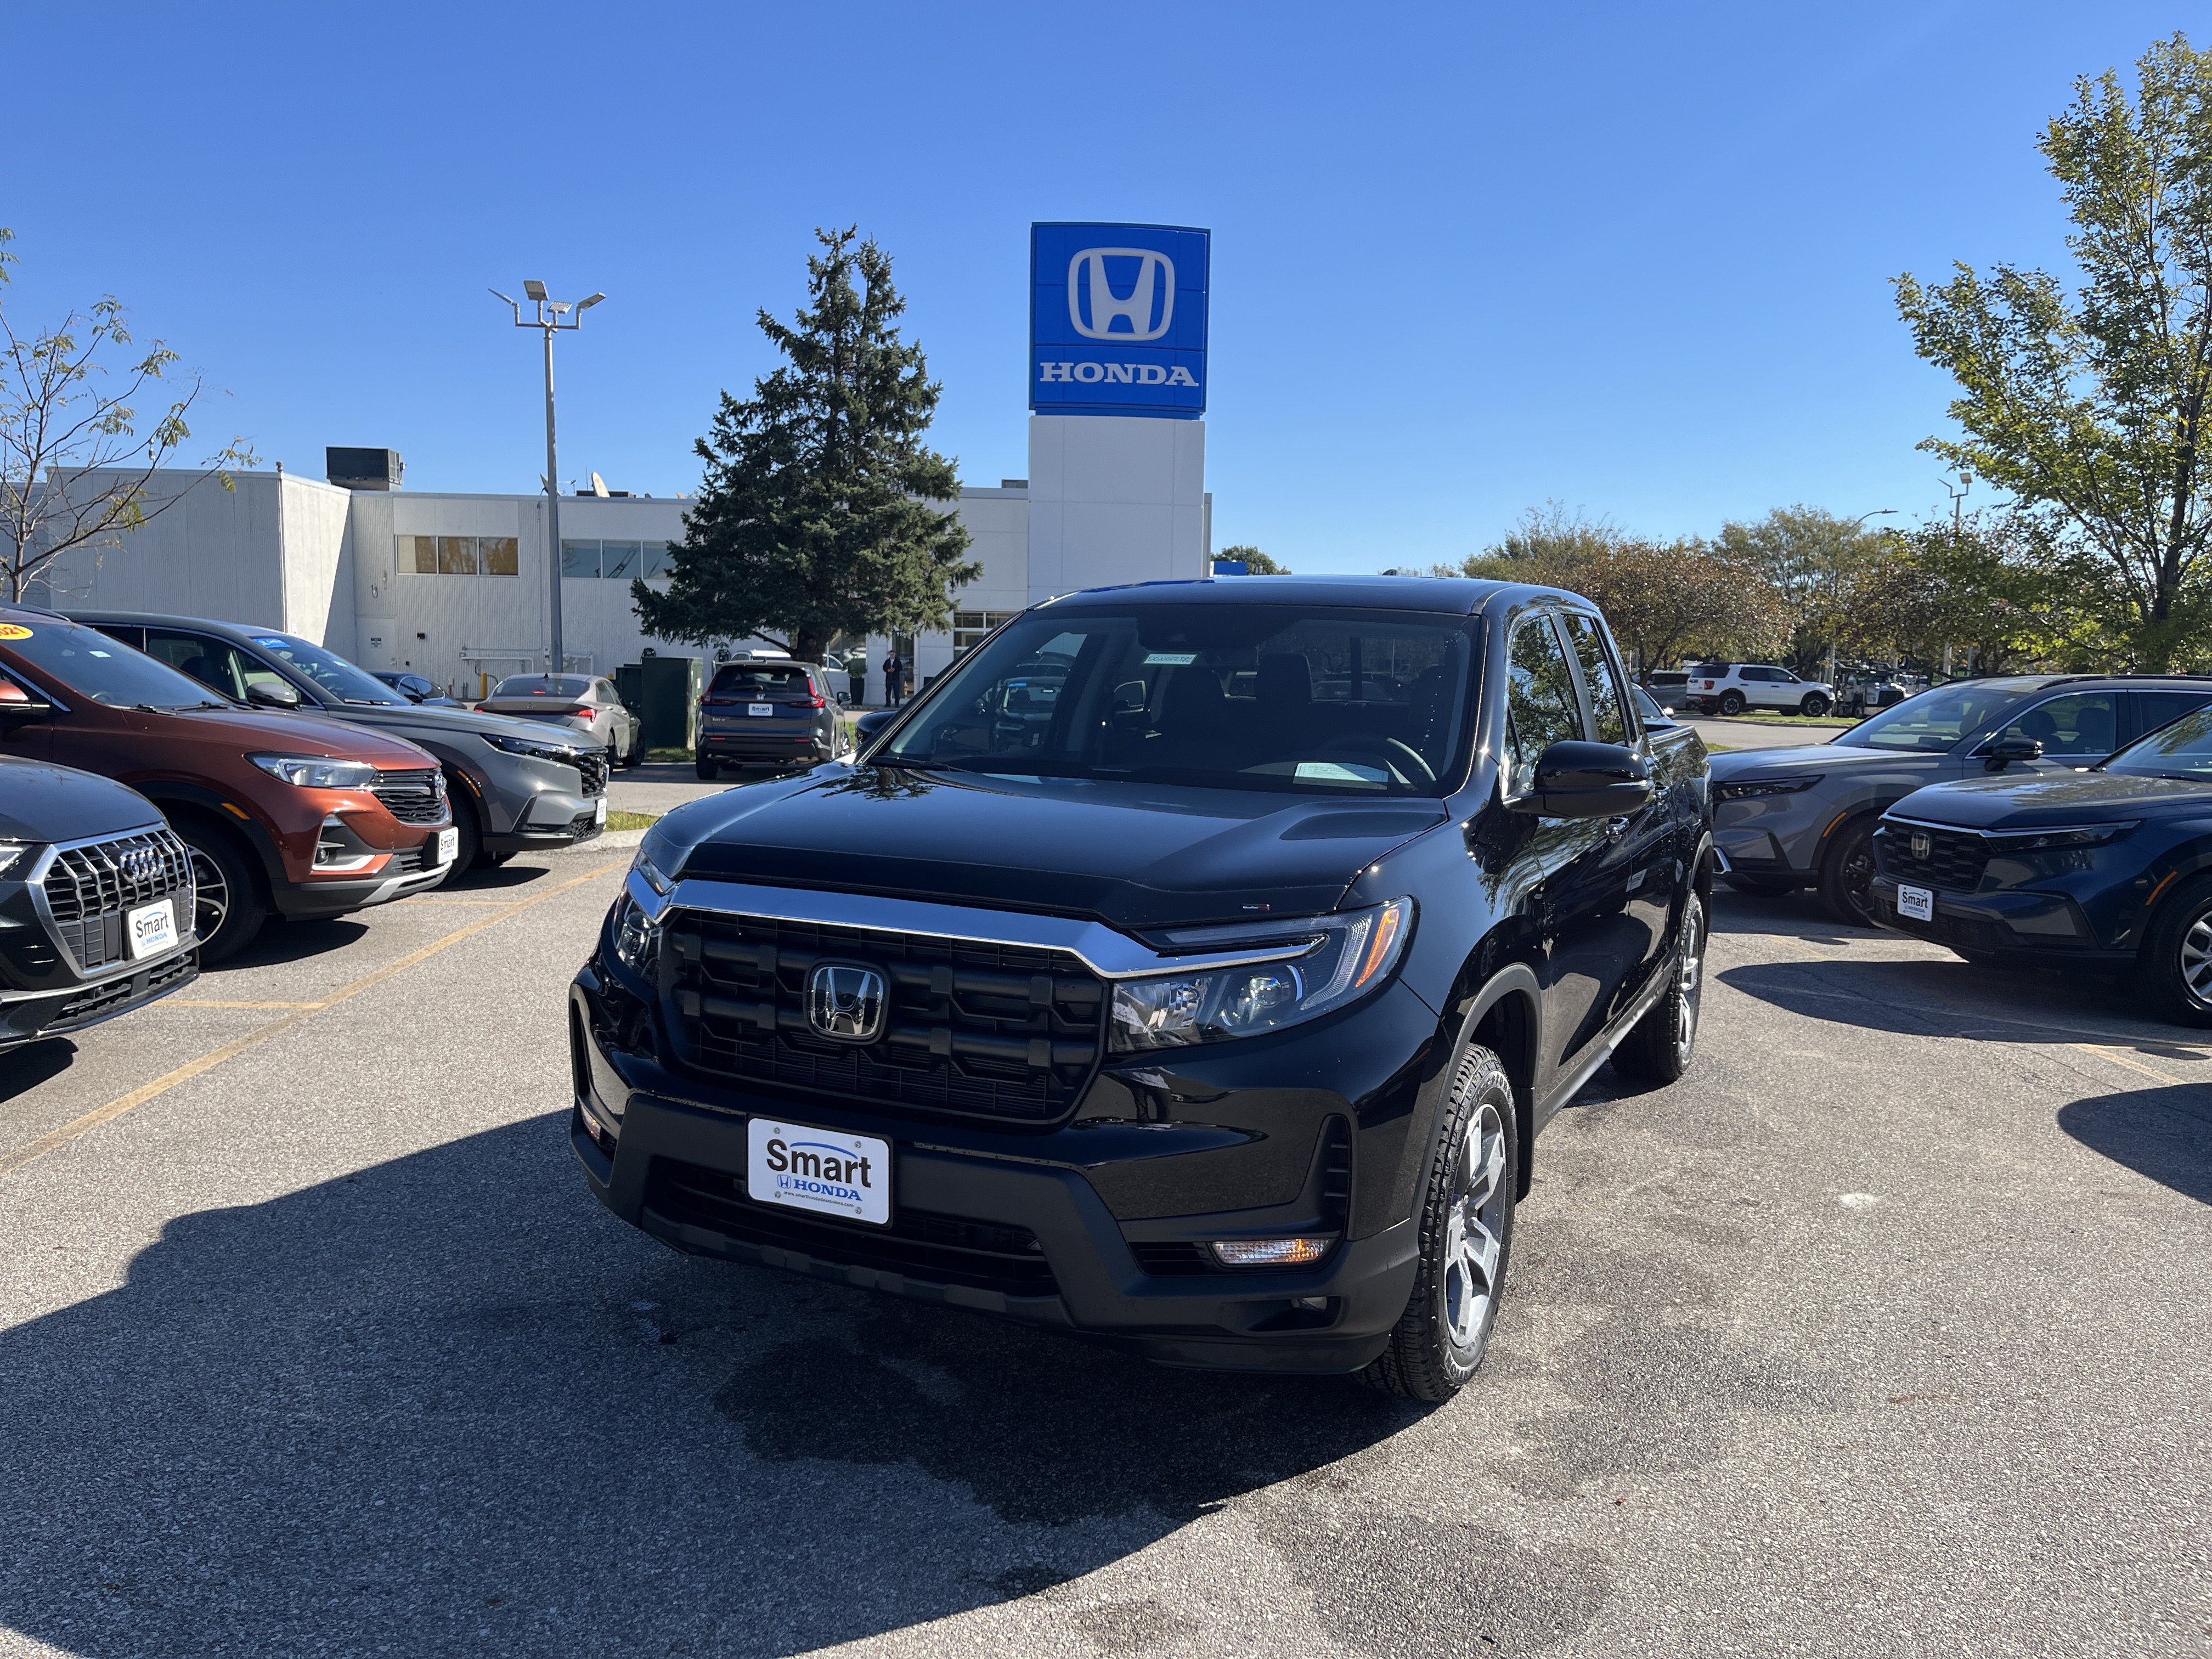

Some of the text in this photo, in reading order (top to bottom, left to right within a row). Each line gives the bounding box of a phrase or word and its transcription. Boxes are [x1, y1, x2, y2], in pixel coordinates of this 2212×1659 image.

[1040, 362, 1199, 386] HONDA
[441, 836, 455, 851] Smart
[1902, 891, 1928, 909] Smart
[136, 912, 168, 938] Smart
[146, 932, 167, 944] HONDA
[766, 1139, 871, 1188] Smart
[794, 1179, 862, 1201] HONDA
